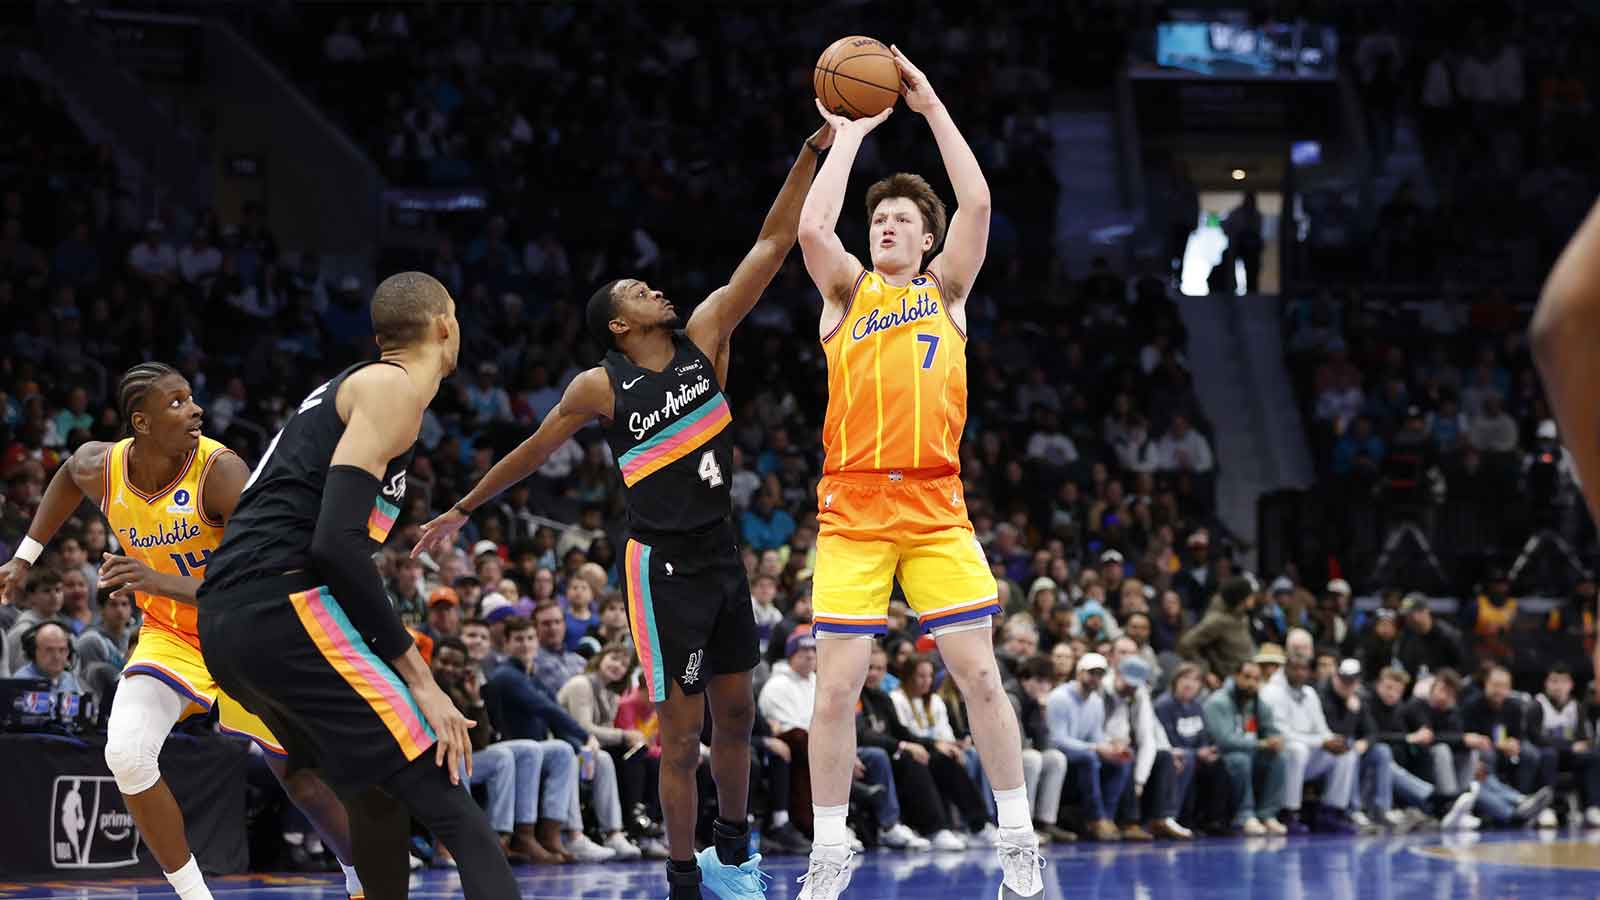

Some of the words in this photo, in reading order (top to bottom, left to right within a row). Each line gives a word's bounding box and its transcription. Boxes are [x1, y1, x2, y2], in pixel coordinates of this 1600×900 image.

[852, 293, 938, 341] Charlotte
[917, 334, 940, 369] 7
[629, 412, 660, 440] San
[661, 375, 710, 418] Antonio
[698, 449, 724, 488] 4
[120, 518, 200, 548] harlotte
